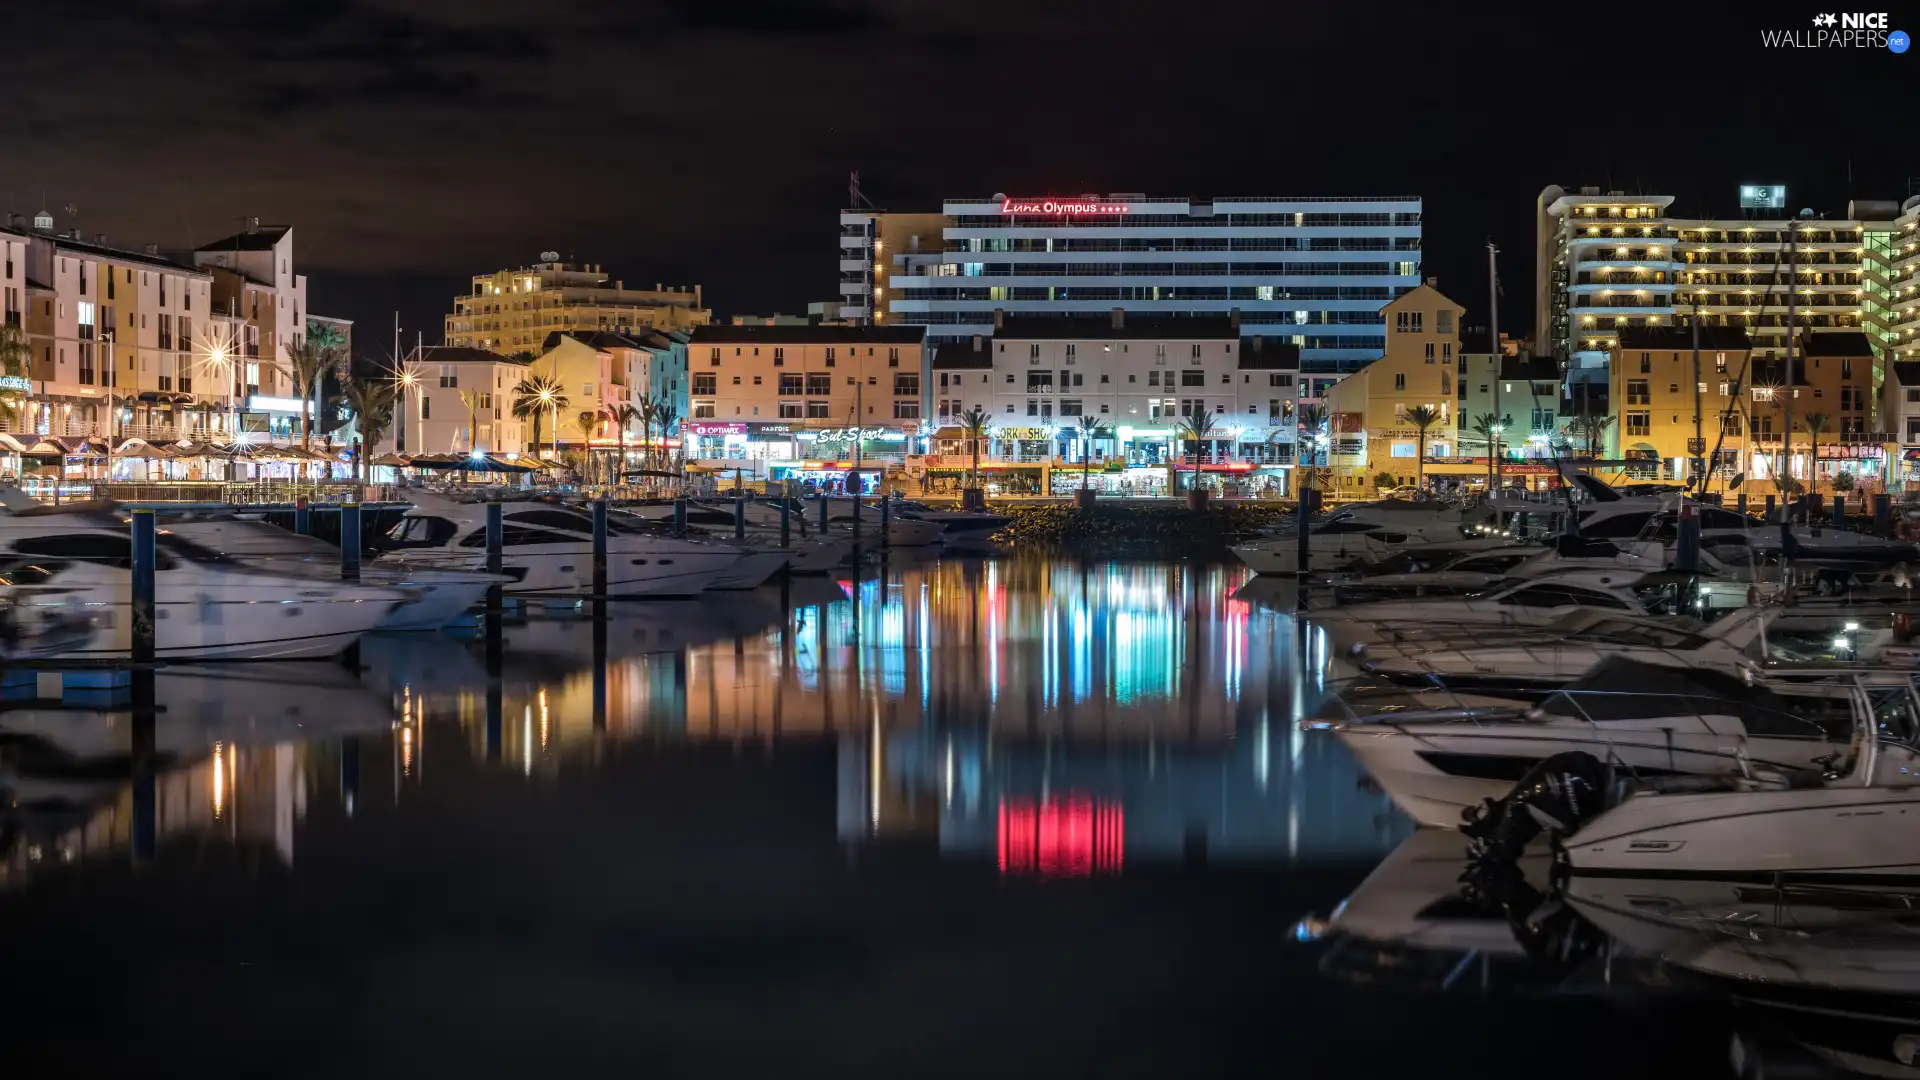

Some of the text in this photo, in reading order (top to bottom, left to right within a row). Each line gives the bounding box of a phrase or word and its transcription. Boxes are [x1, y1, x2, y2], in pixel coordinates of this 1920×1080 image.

[1003, 199, 1097, 215] Luna Olympus
[817, 427, 885, 443] Sul-Sport
